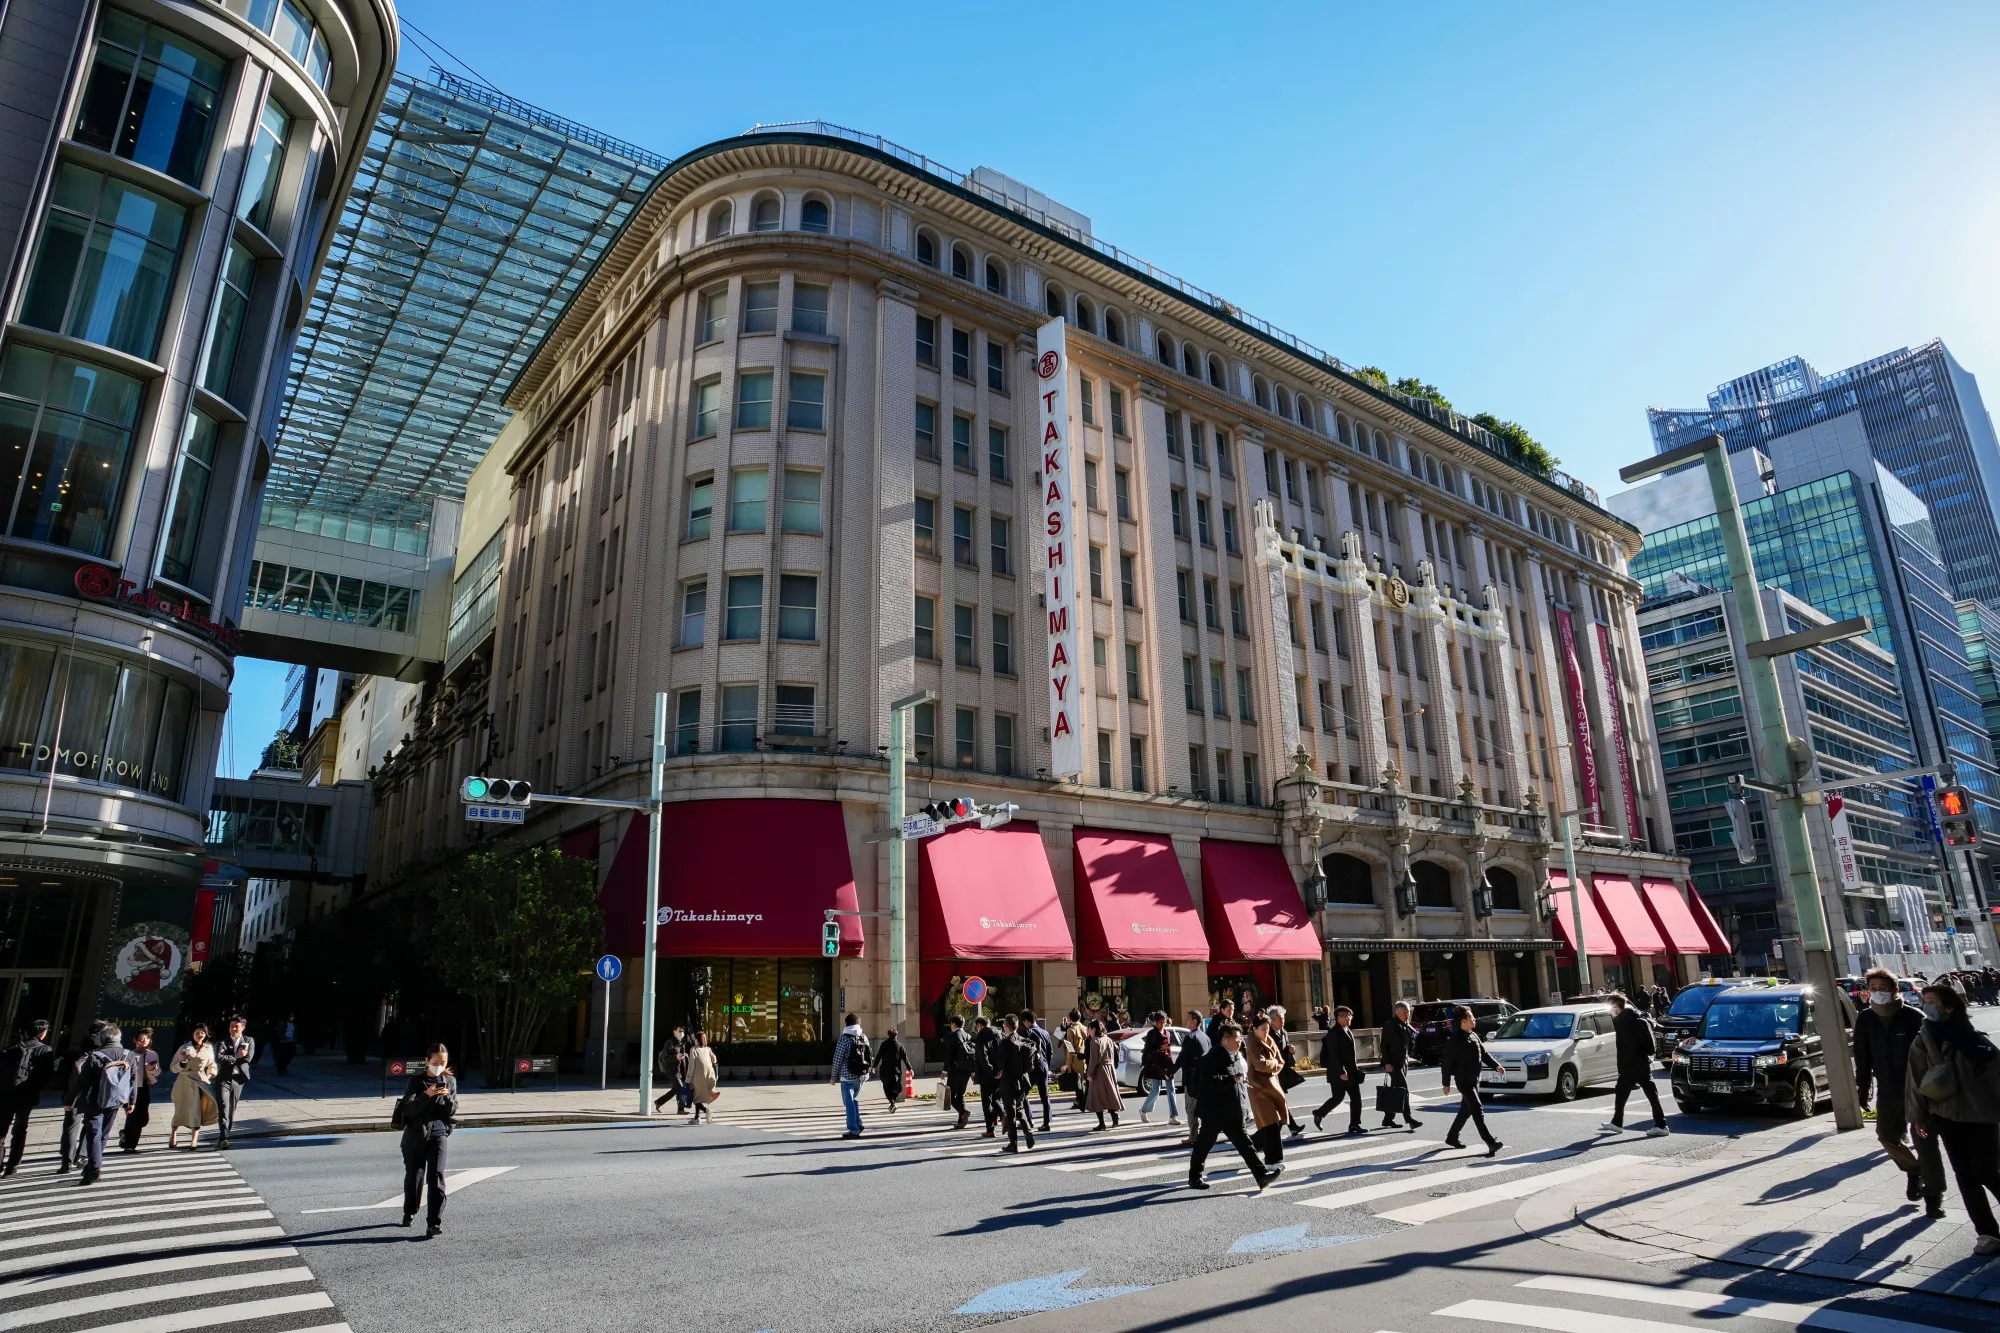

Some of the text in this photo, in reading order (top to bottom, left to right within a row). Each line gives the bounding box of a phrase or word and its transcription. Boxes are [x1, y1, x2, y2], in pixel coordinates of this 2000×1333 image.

[1043, 390, 1071, 738] TAKASHIMAYA
[469, 807, 521, 820] 自転車専用
[1838, 836, 1855, 882] 百十四銀行
[674, 909, 763, 925] Takashimaya
[990, 919, 1037, 931] Takashimaya
[723, 1005, 755, 1013] ROLEX
[109, 1016, 182, 1027] hristmas
